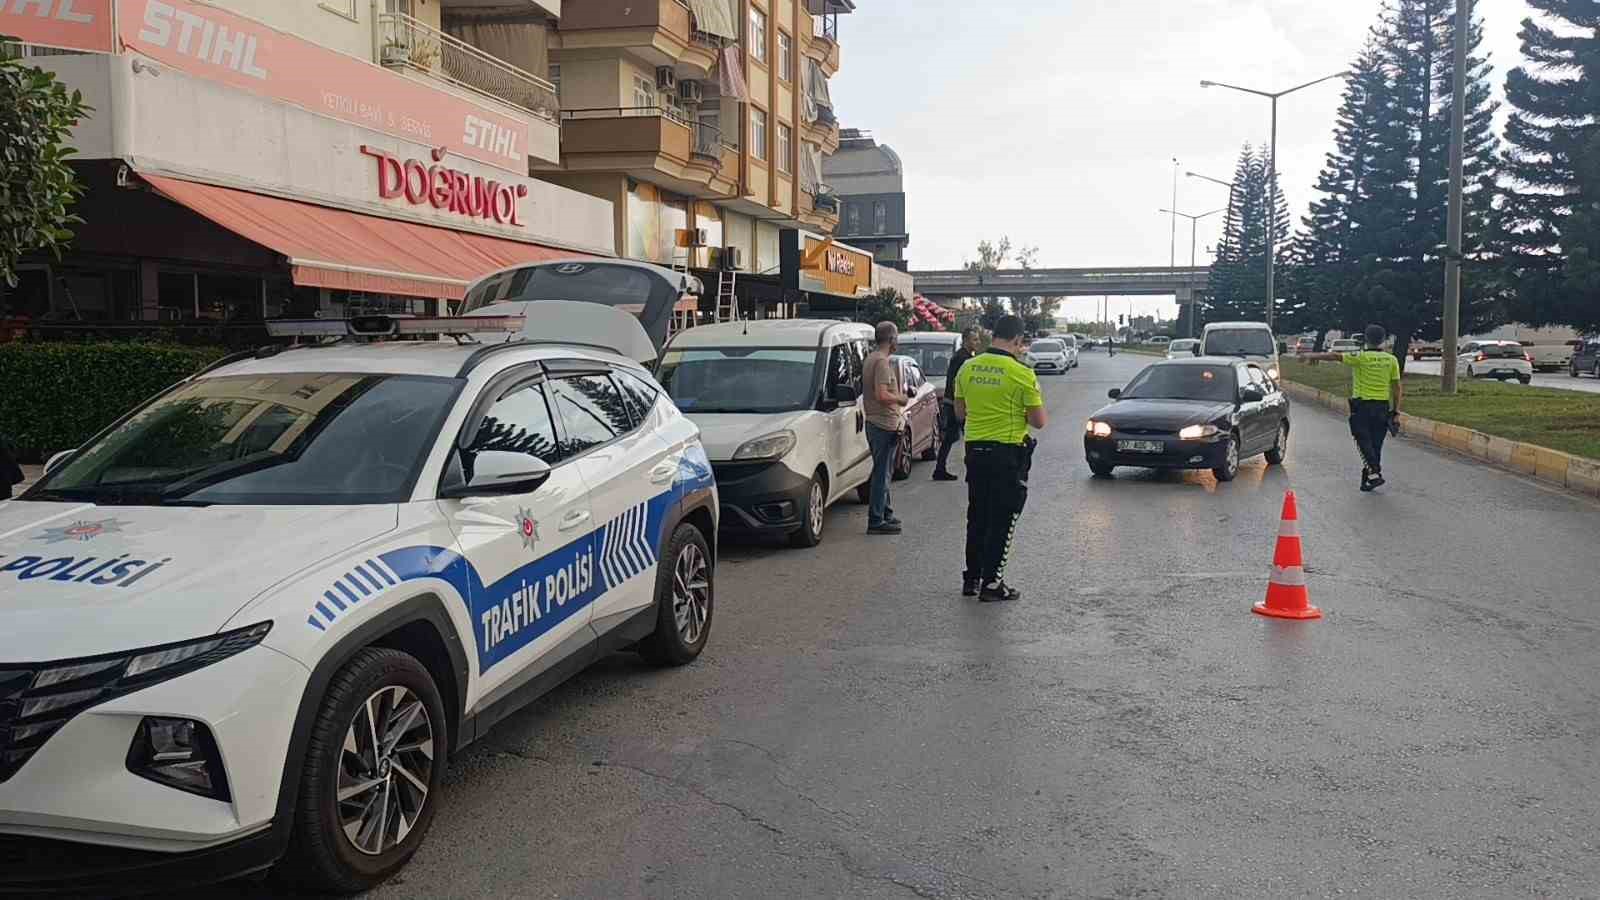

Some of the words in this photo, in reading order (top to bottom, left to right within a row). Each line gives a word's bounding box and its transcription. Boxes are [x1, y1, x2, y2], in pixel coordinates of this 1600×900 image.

[139, 2, 267, 80] STIHL
[463, 114, 520, 160] STIHL
[482, 579, 541, 652] TRAFİK
[545, 545, 593, 613] POLİSİ
